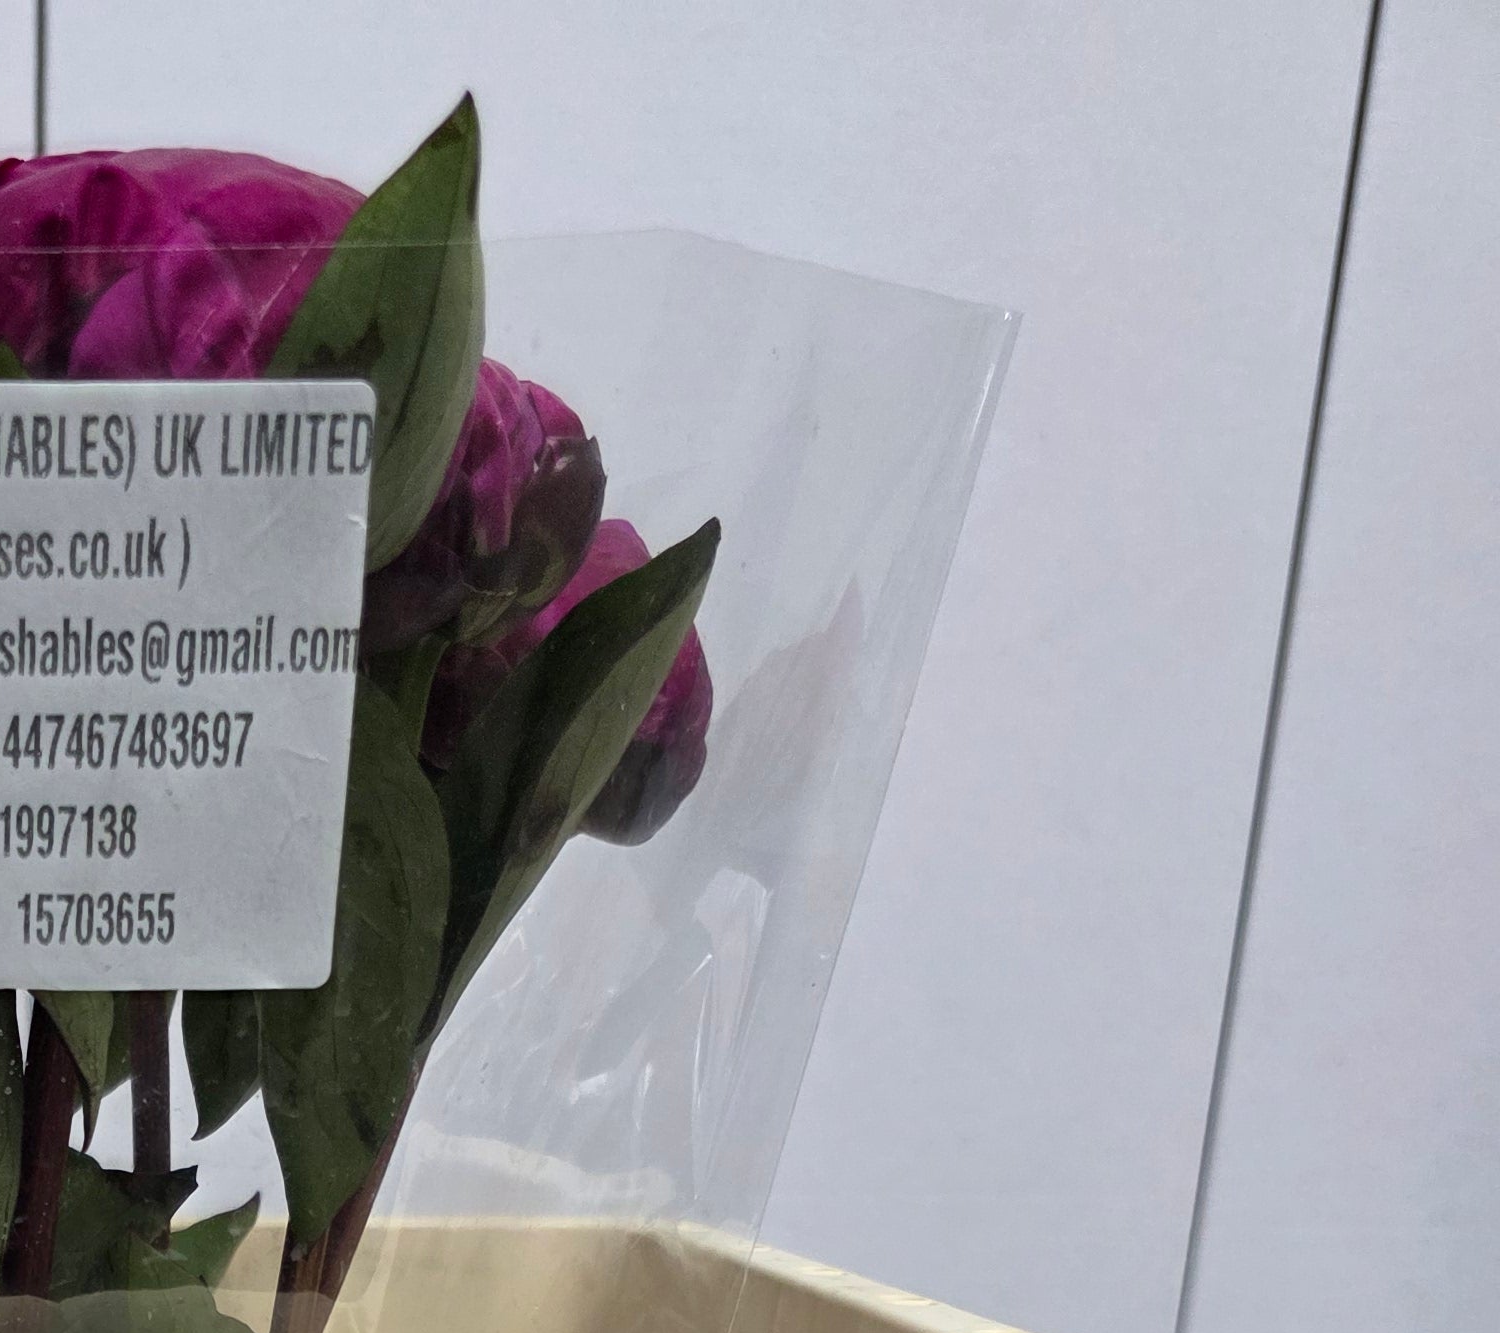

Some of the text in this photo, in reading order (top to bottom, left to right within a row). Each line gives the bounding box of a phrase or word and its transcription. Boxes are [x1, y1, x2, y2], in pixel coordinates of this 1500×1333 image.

[155, 413, 205, 478] UK
[219, 412, 373, 478] LIMITED
[18, 892, 176, 946] 15703655
